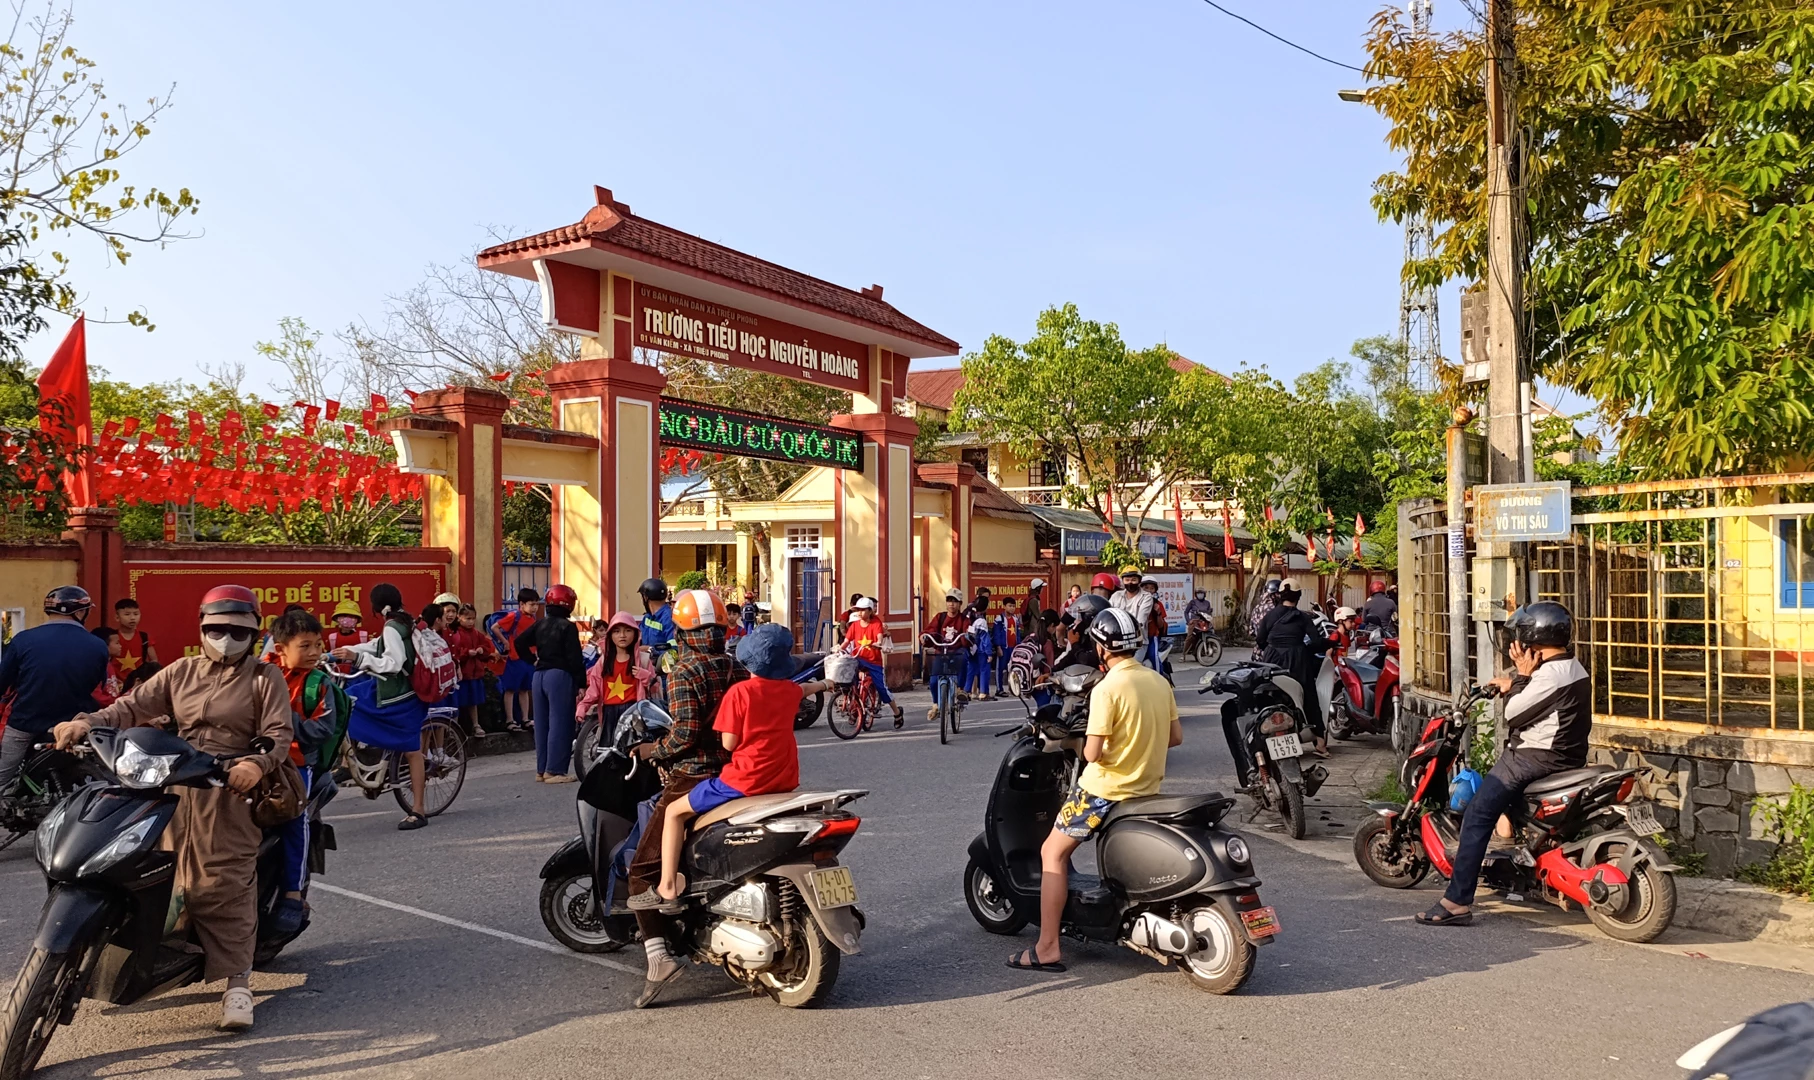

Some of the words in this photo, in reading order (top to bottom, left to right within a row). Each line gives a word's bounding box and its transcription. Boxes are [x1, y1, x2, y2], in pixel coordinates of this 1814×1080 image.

[652, 290, 668, 302] BAN
[736, 313, 758, 326] PHONG
[640, 333, 648, 343] 01
[710, 349, 730, 361] PHONG
[643, 307, 704, 344] TRƯỜNG
[706, 319, 737, 351] TIỂU
[740, 331, 767, 361] HỌC
[769, 339, 818, 370] NGUYỄN
[821, 351, 859, 380] HOÀNG
[697, 413, 743, 447] BẦU
[747, 422, 778, 451] CỬ
[780, 430, 833, 459] QUỐC
[1500, 495, 1542, 508] ĐƯỜNG
[1496, 512, 1509, 531] VÕ
[1511, 515, 1527, 533] THỊ
[1529, 511, 1548, 530] SÁU
[285, 580, 314, 603] ĐỂ
[319, 582, 362, 602] BIẾT
[1271, 736, 1295, 748] 74-H3
[1274, 745, 1298, 757] 1576
[817, 870, 848, 889] 74-D1
